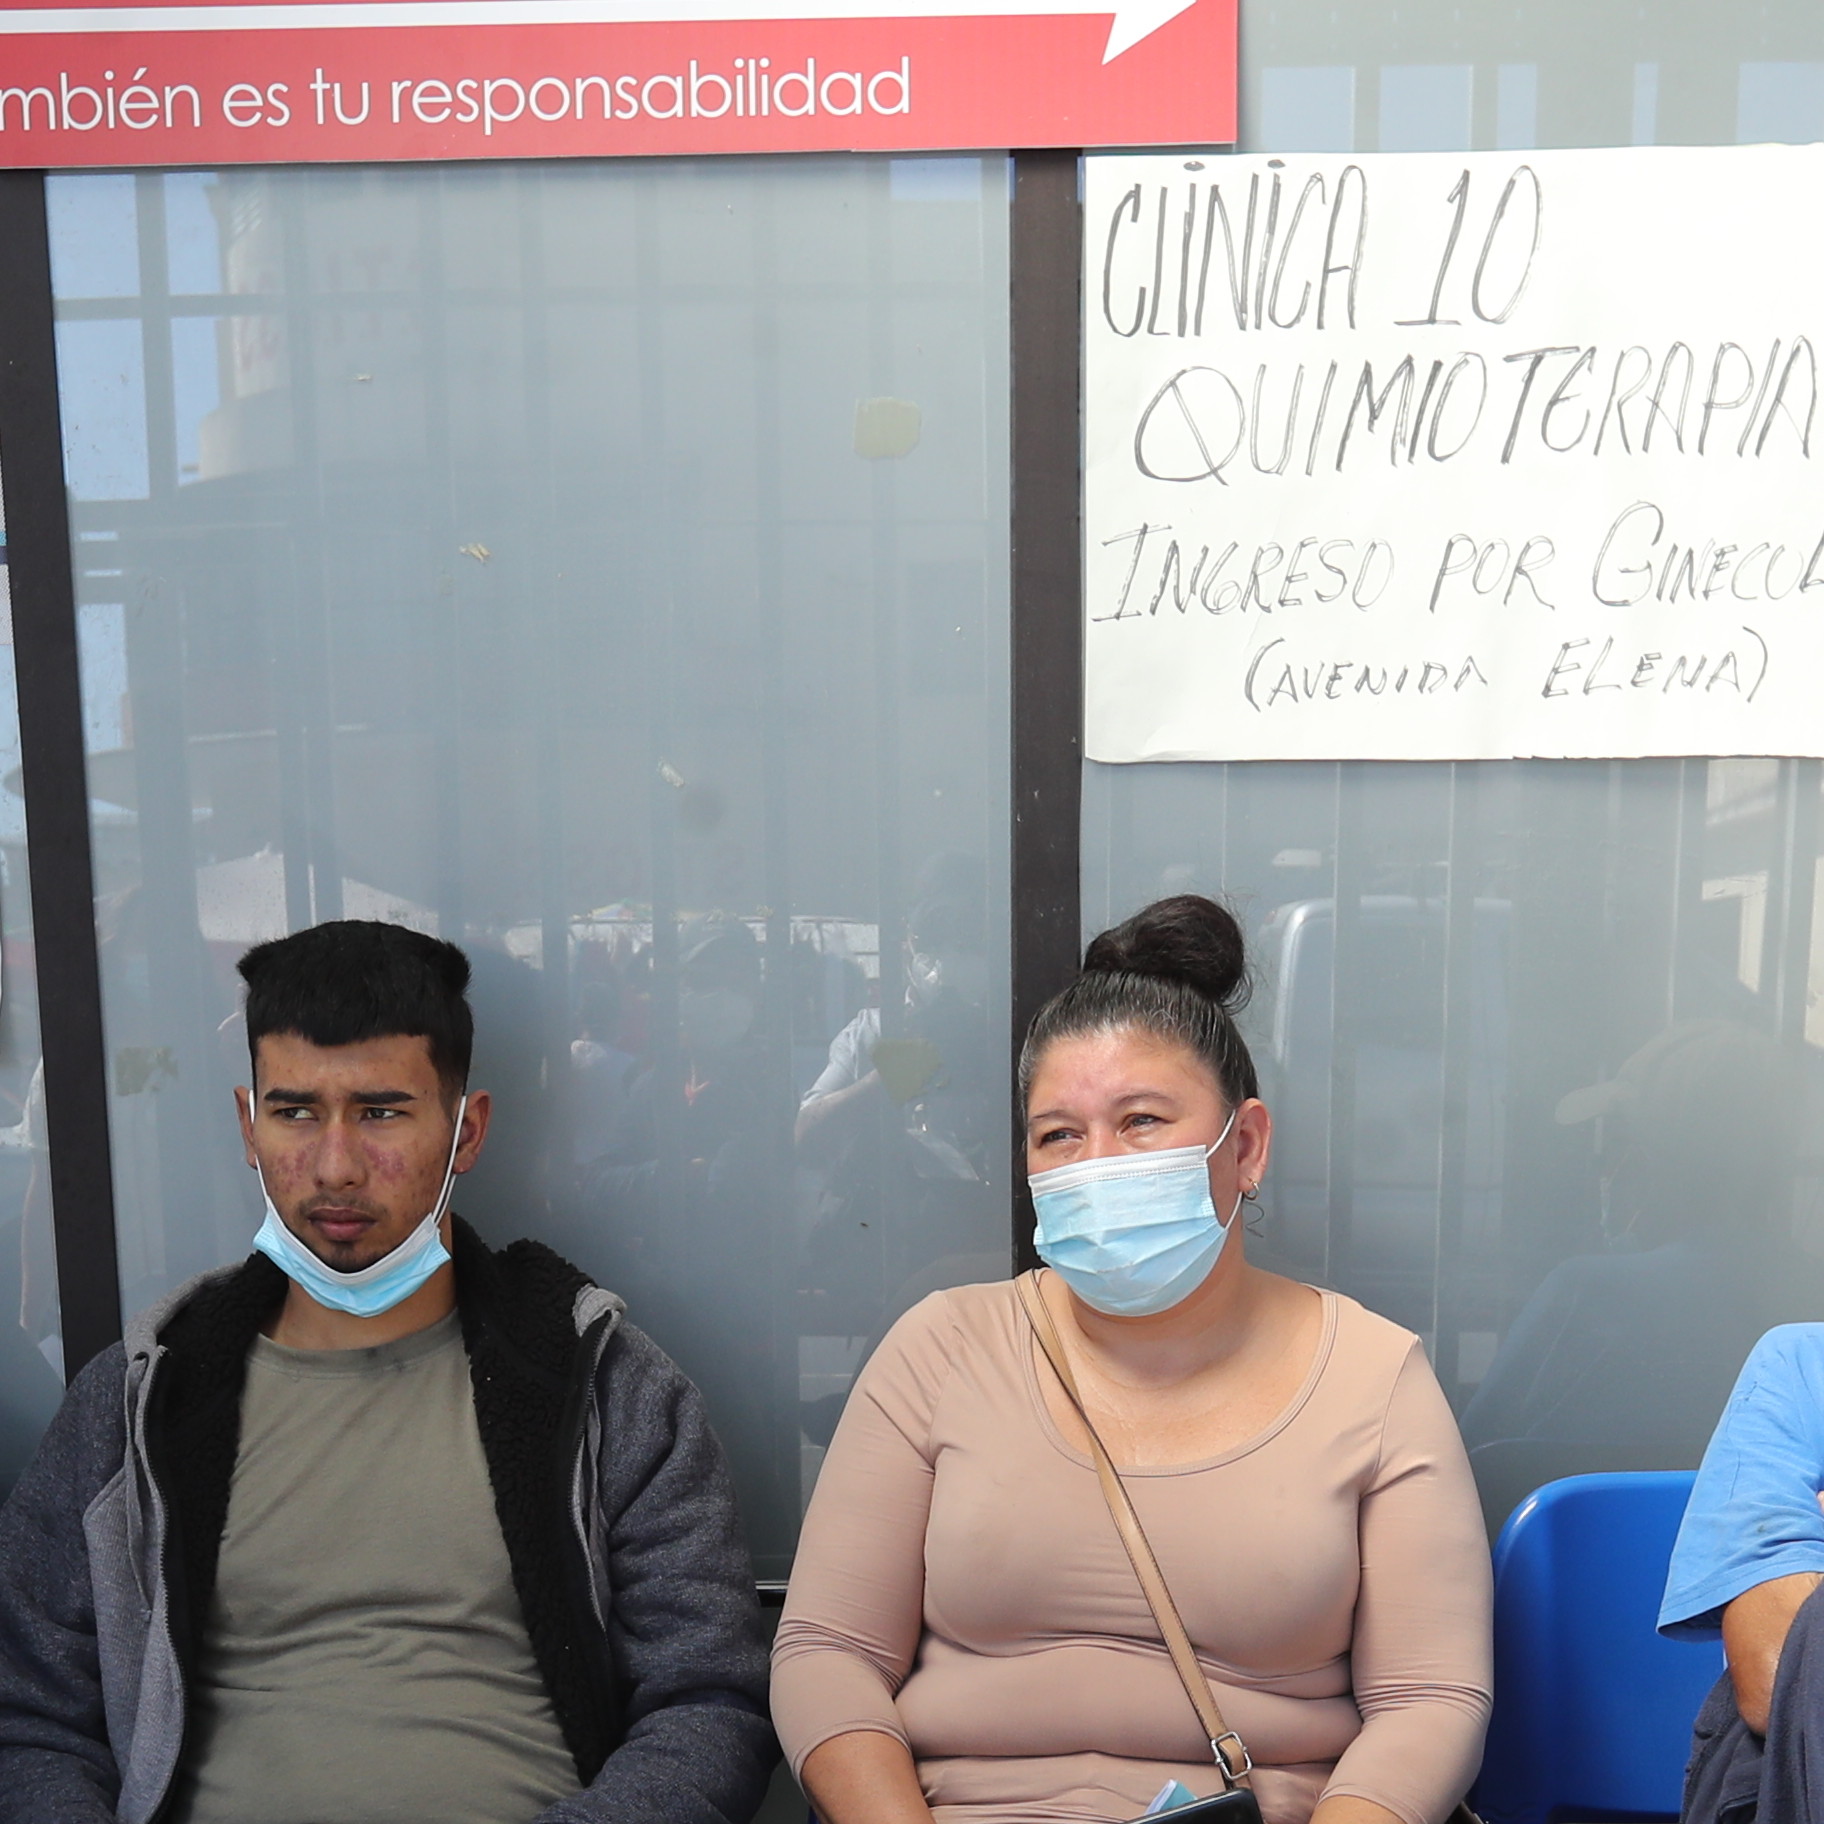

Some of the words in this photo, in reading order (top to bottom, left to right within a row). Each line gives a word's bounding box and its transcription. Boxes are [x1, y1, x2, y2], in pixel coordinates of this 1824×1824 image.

[222, 80, 291, 129] es
[309, 68, 369, 126] tu
[389, 56, 912, 136] responsabilidad
[1394, 164, 1544, 328] 10
[1134, 335, 1819, 486] QUIMIOTERAPIA
[1091, 521, 1396, 624] INGRESO
[1428, 532, 1556, 613] POR
[1244, 635, 1491, 714] (AVENIDA
[1541, 625, 1772, 705] ELENA)
